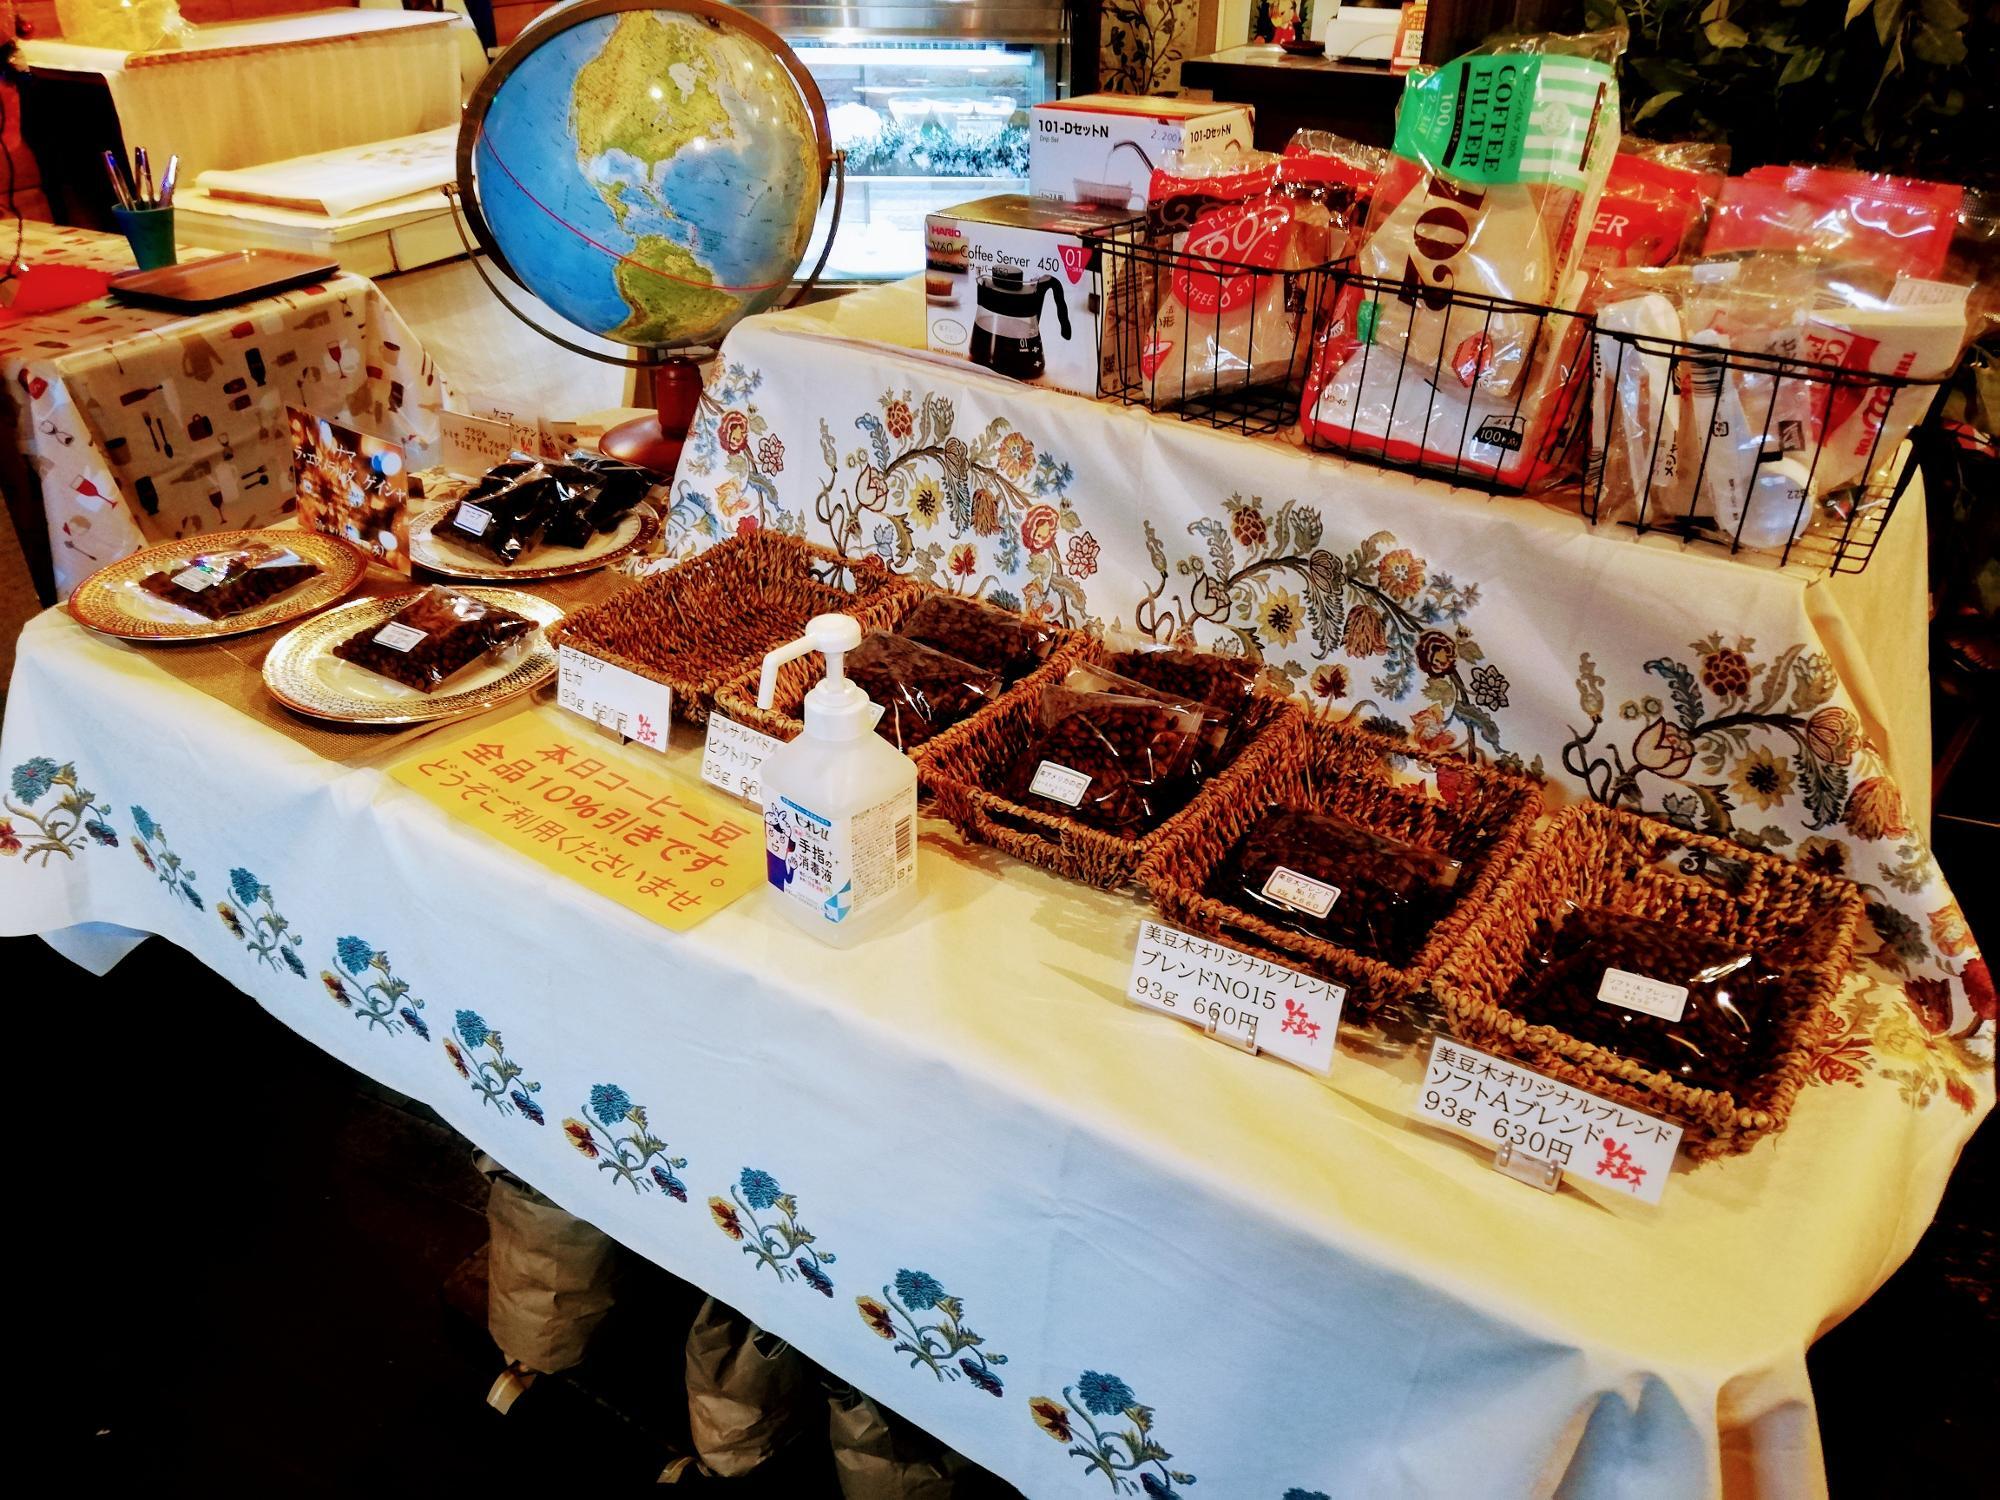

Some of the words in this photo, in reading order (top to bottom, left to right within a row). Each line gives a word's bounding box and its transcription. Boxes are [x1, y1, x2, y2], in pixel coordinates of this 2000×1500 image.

[1038, 119, 1109, 138] 101-DセットN
[1189, 123, 1232, 143] 101-DセットN
[1459, 69, 1493, 168] FILTER
[1482, 65, 1517, 173] COFFEE
[931, 226, 961, 239] HARIO
[1590, 212, 1630, 238] ER
[960, 244, 994, 263] Coffee
[996, 250, 1031, 268] Server
[1037, 257, 1060, 273] 450
[1065, 249, 1083, 267] 01
[1178, 275, 1216, 307] COFFEE
[493, 407, 514, 421] ケニア
[363, 474, 407, 503] ゲイシャ
[561, 649, 605, 673] エチオピア
[561, 667, 583, 687] モカ
[561, 688, 585, 712] 93g
[708, 736, 762, 771] ビクトリア
[704, 760, 731, 786] 93g
[535, 742, 751, 850] 本日コーヒー豆
[461, 741, 730, 890] 全品10%引きです。
[417, 758, 703, 913] どうぞご利用くださいませ
[798, 837, 833, 869] 手指の
[798, 854, 833, 885] 消毒液
[1144, 924, 1340, 1002] 美豆木オリジナルブレンド
[1140, 950, 1277, 1010] ブレンドNO15
[1135, 976, 1179, 1008] 93g
[1193, 996, 1259, 1031] 660円
[1431, 1067, 1605, 1146] ソフトAブレンド
[1435, 1045, 1673, 1145] 美豆木オリジナルブレンド
[1424, 1090, 1477, 1128] 93g
[1493, 1118, 1574, 1167] 630円
